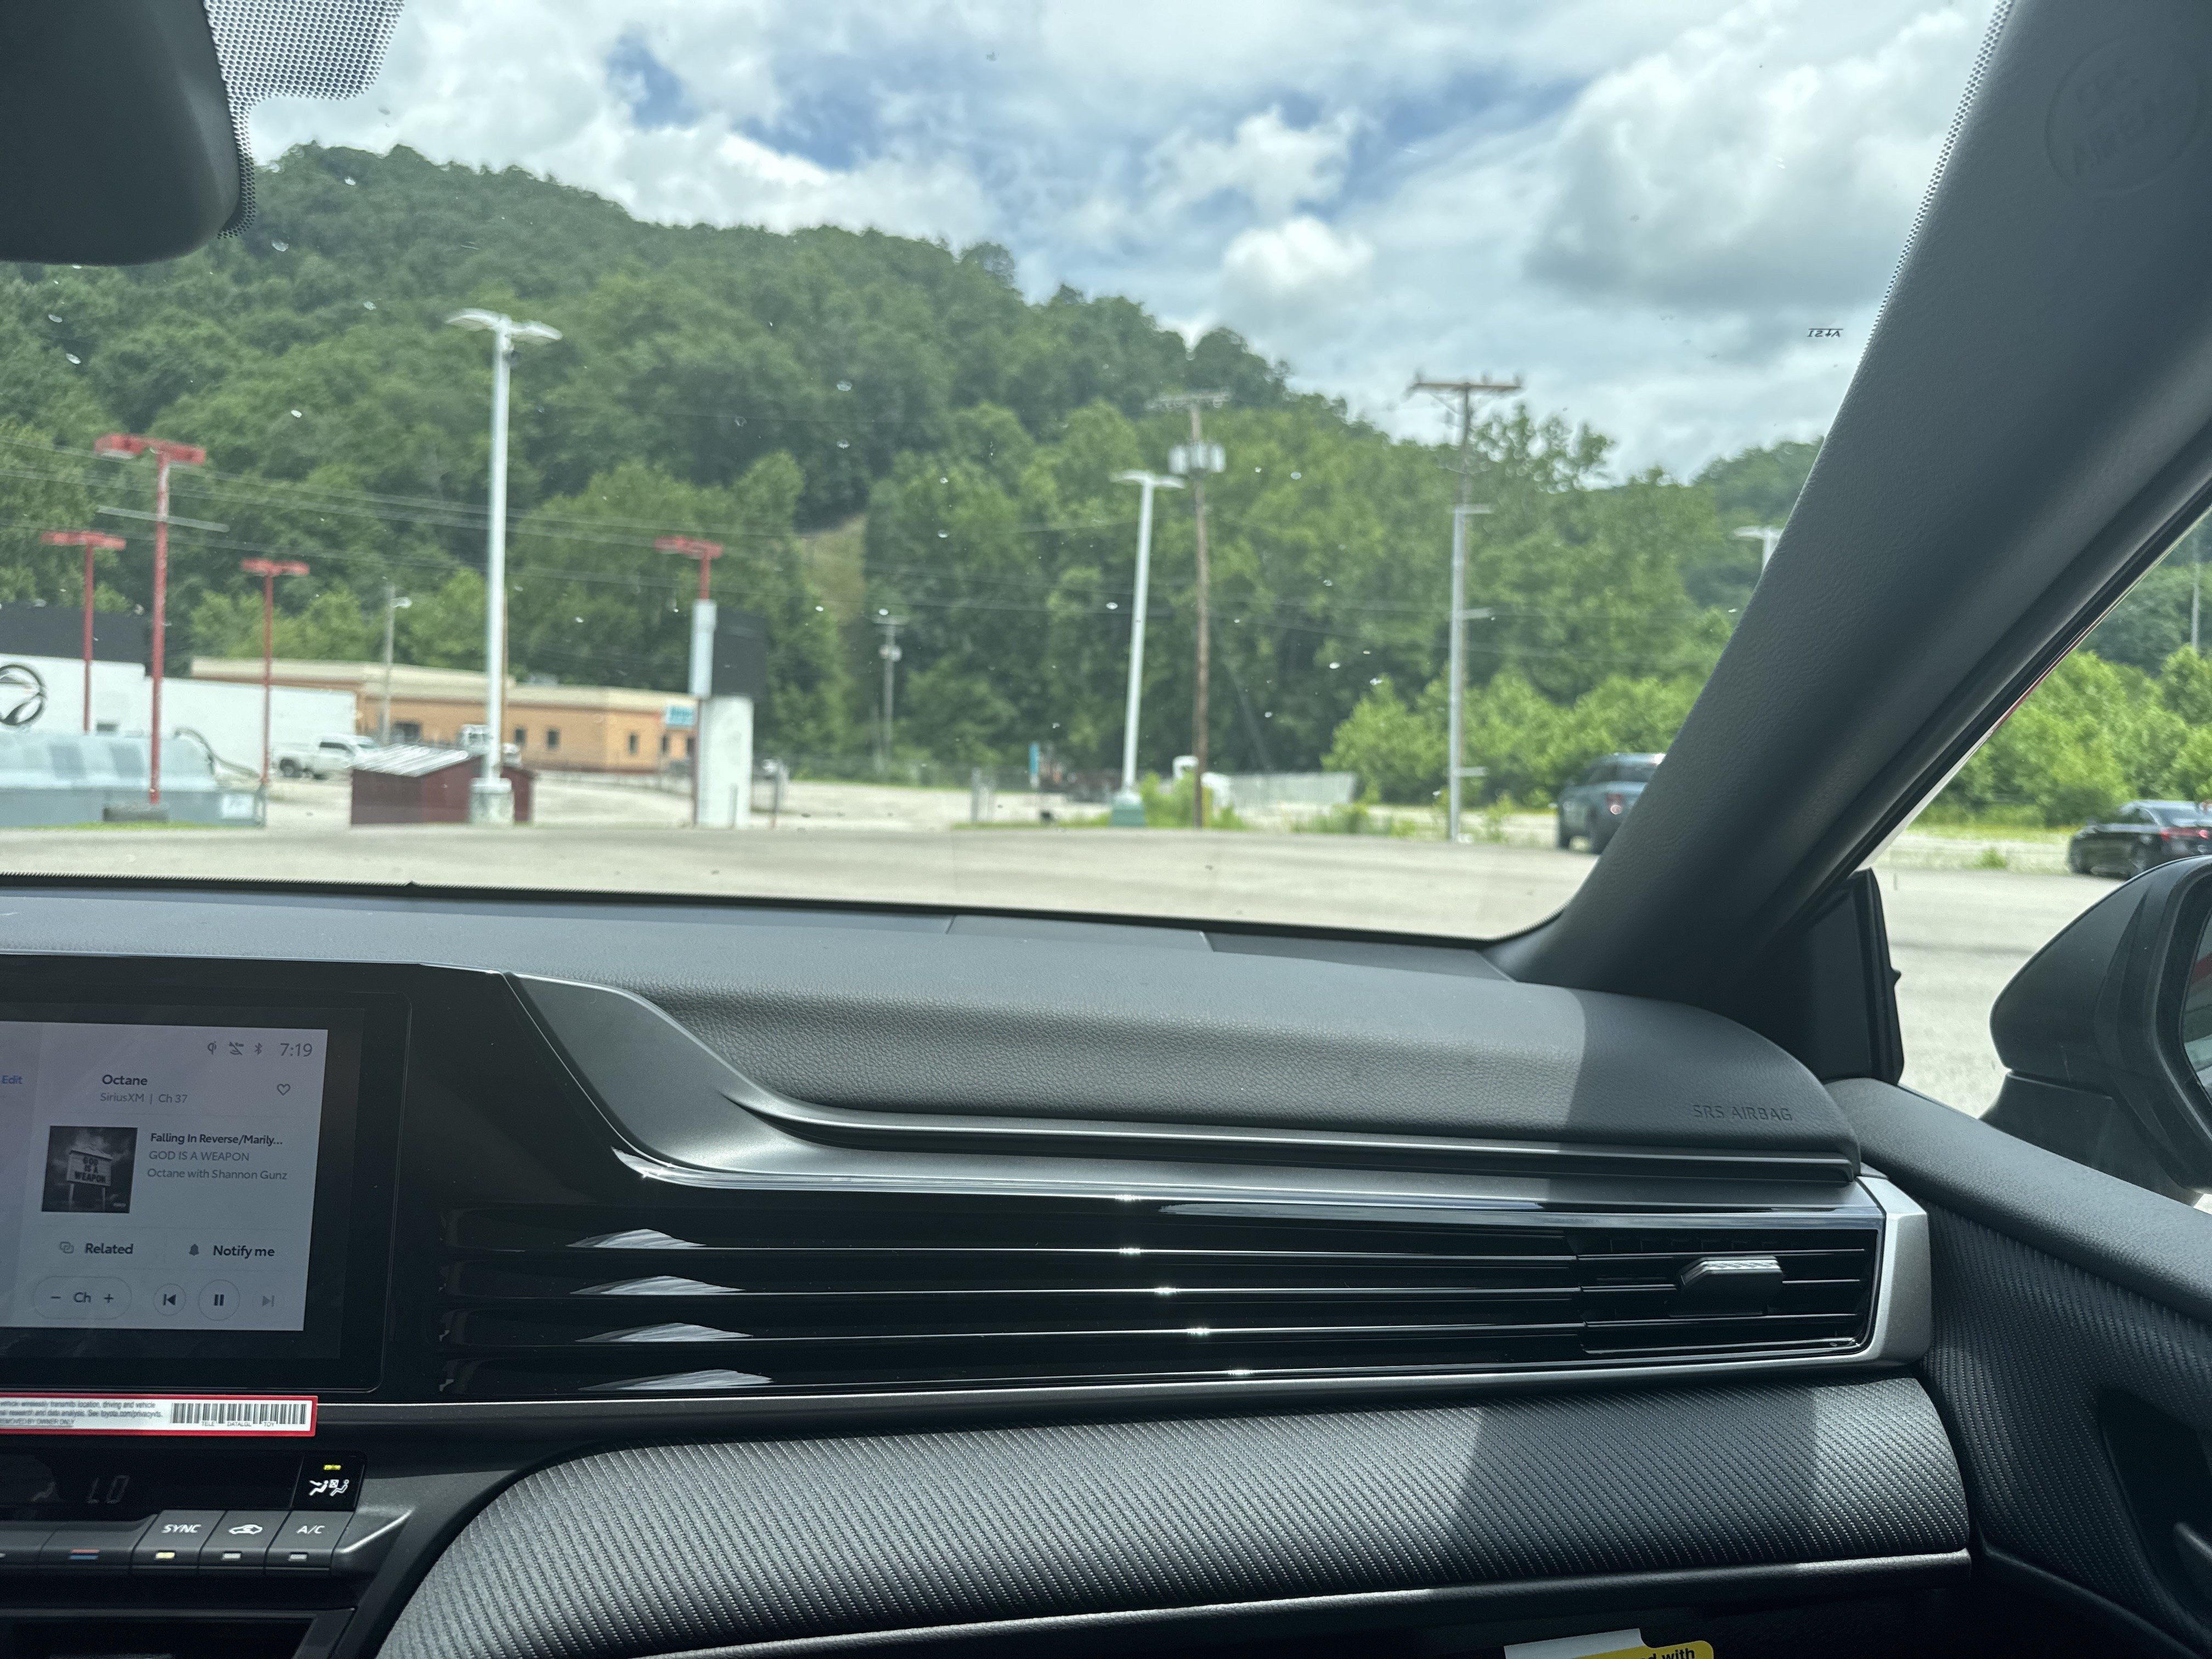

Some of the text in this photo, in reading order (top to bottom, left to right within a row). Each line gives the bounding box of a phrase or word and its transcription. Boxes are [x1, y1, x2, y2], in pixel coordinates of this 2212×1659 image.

[280, 1043, 313, 1057] 7:19
[1, 1075, 22, 1085] Edit
[102, 1074, 148, 1086] Octane
[100, 1092, 144, 1103] SiriusXM
[158, 1093, 172, 1103] Ch
[174, 1094, 188, 1103] 37
[1692, 1104, 1792, 1121] SRS AIRBAG
[150, 1133, 185, 1145] Falling
[187, 1134, 196, 1143] In
[149, 1151, 249, 1161] GOD IS A WEAPON
[147, 1169, 287, 1180] Octane with Shannon Gunz
[85, 1243, 133, 1255] Related
[213, 1245, 275, 1259] Notify me
[74, 1292, 92, 1303] Ch
[103, 1401, 122, 1409] driving
[162, 1524, 201, 1533] SYNC
[297, 1525, 325, 1534] A/C
